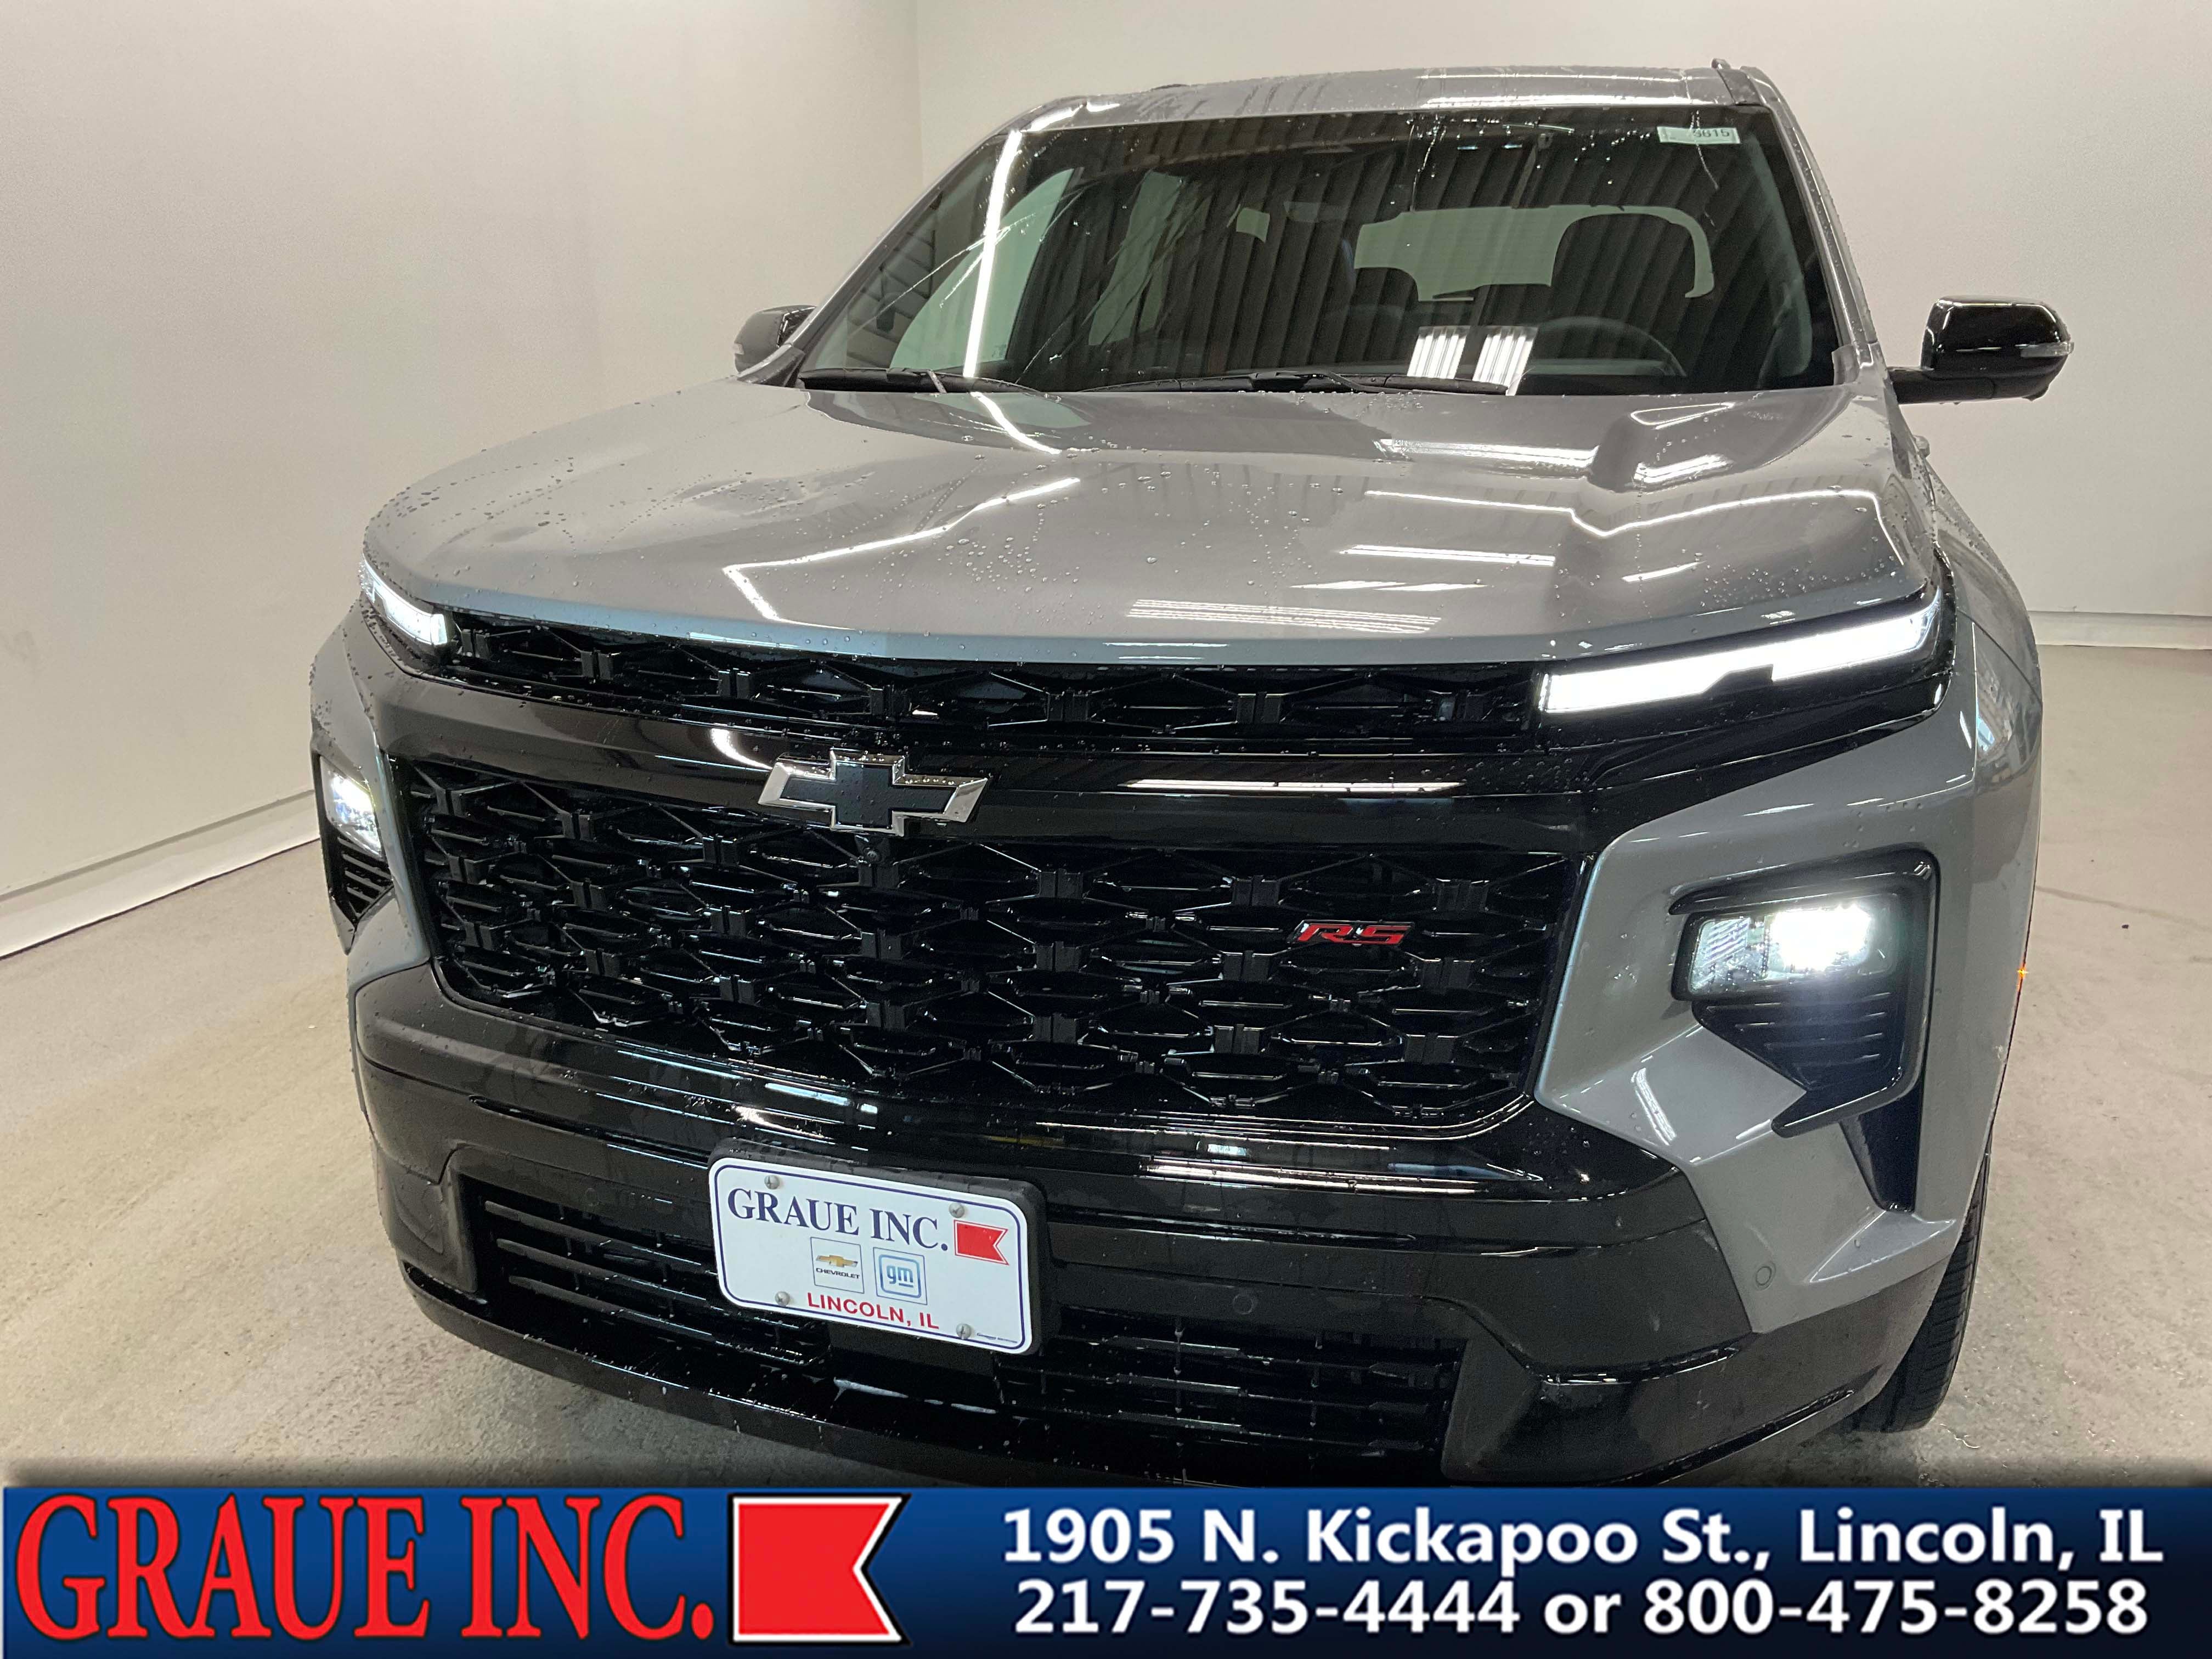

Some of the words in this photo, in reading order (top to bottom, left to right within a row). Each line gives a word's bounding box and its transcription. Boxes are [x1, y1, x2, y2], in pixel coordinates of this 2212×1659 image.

[1296, 922, 1412, 945] RS
[727, 1188, 859, 1235] GRAUE
[870, 1209, 948, 1251] INC.
[816, 1268, 860, 1279] CHEVROLET
[887, 1265, 914, 1288] gm
[808, 1293, 911, 1327] LINCOLN,
[919, 1313, 939, 1330] IL
